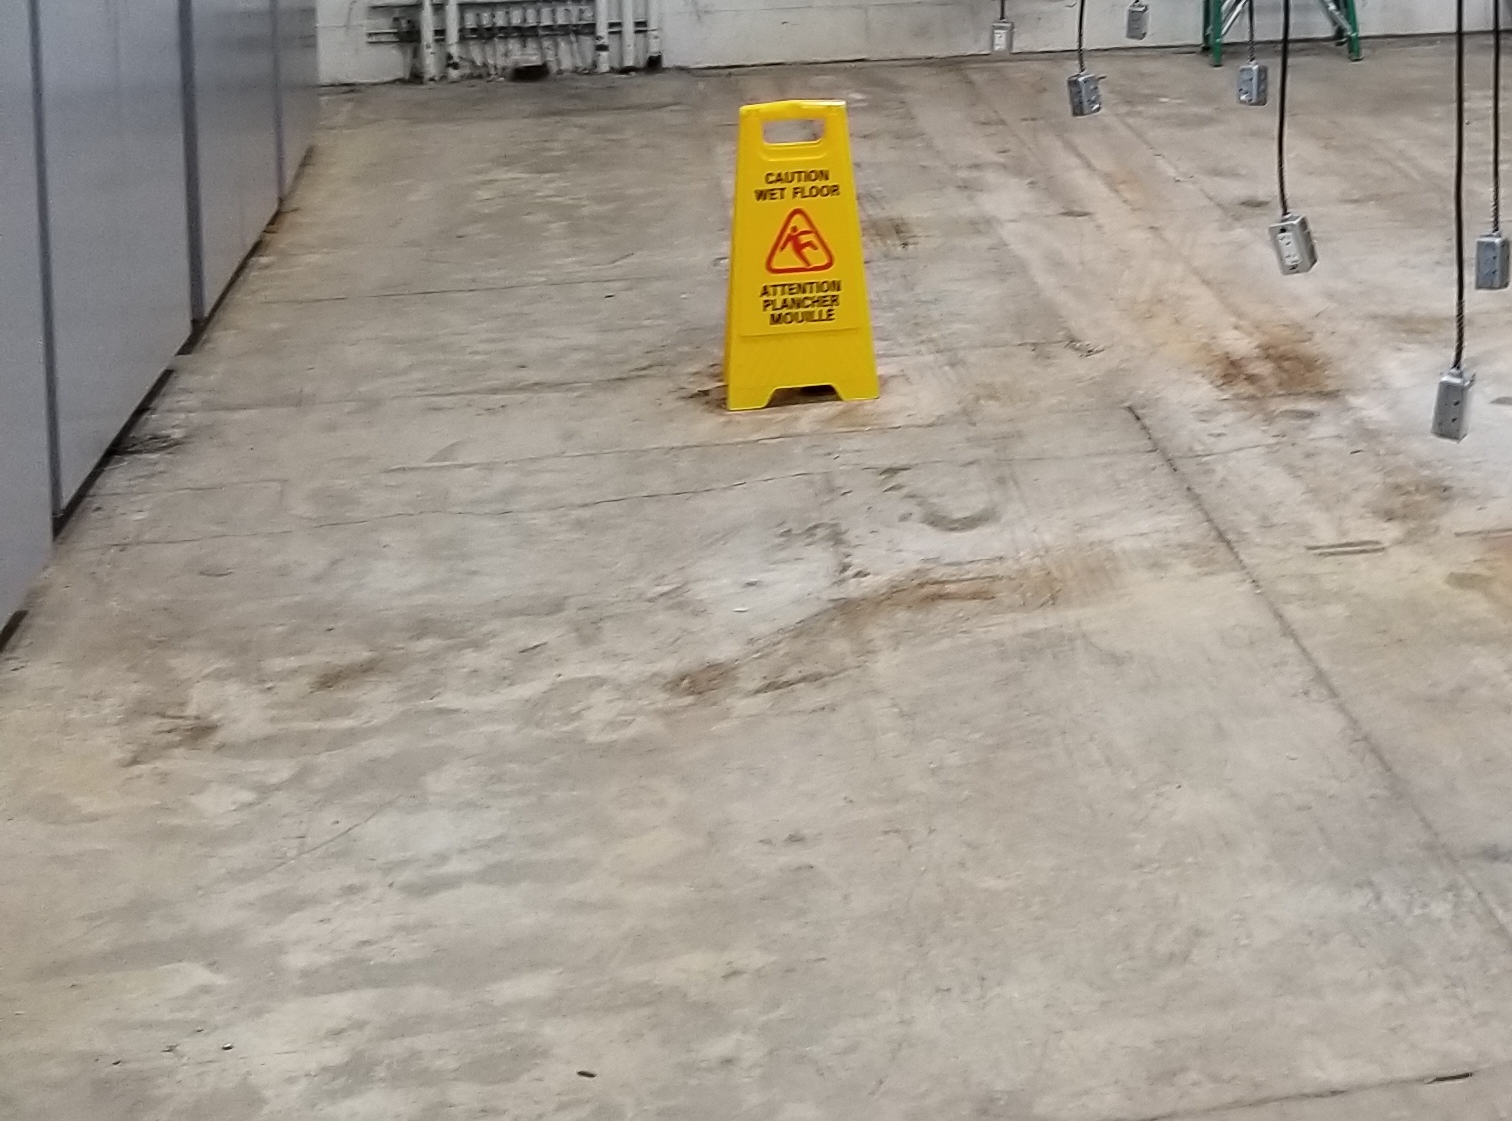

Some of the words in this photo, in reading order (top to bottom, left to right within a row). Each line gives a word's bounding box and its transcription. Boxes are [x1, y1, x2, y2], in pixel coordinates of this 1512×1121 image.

[764, 169, 829, 185] CAUTION
[754, 187, 786, 201] WET
[792, 184, 840, 199] FLOOR
[760, 280, 842, 297] ATTENTION
[763, 294, 840, 312] PLANCHER
[769, 308, 836, 326] MOUILLE
